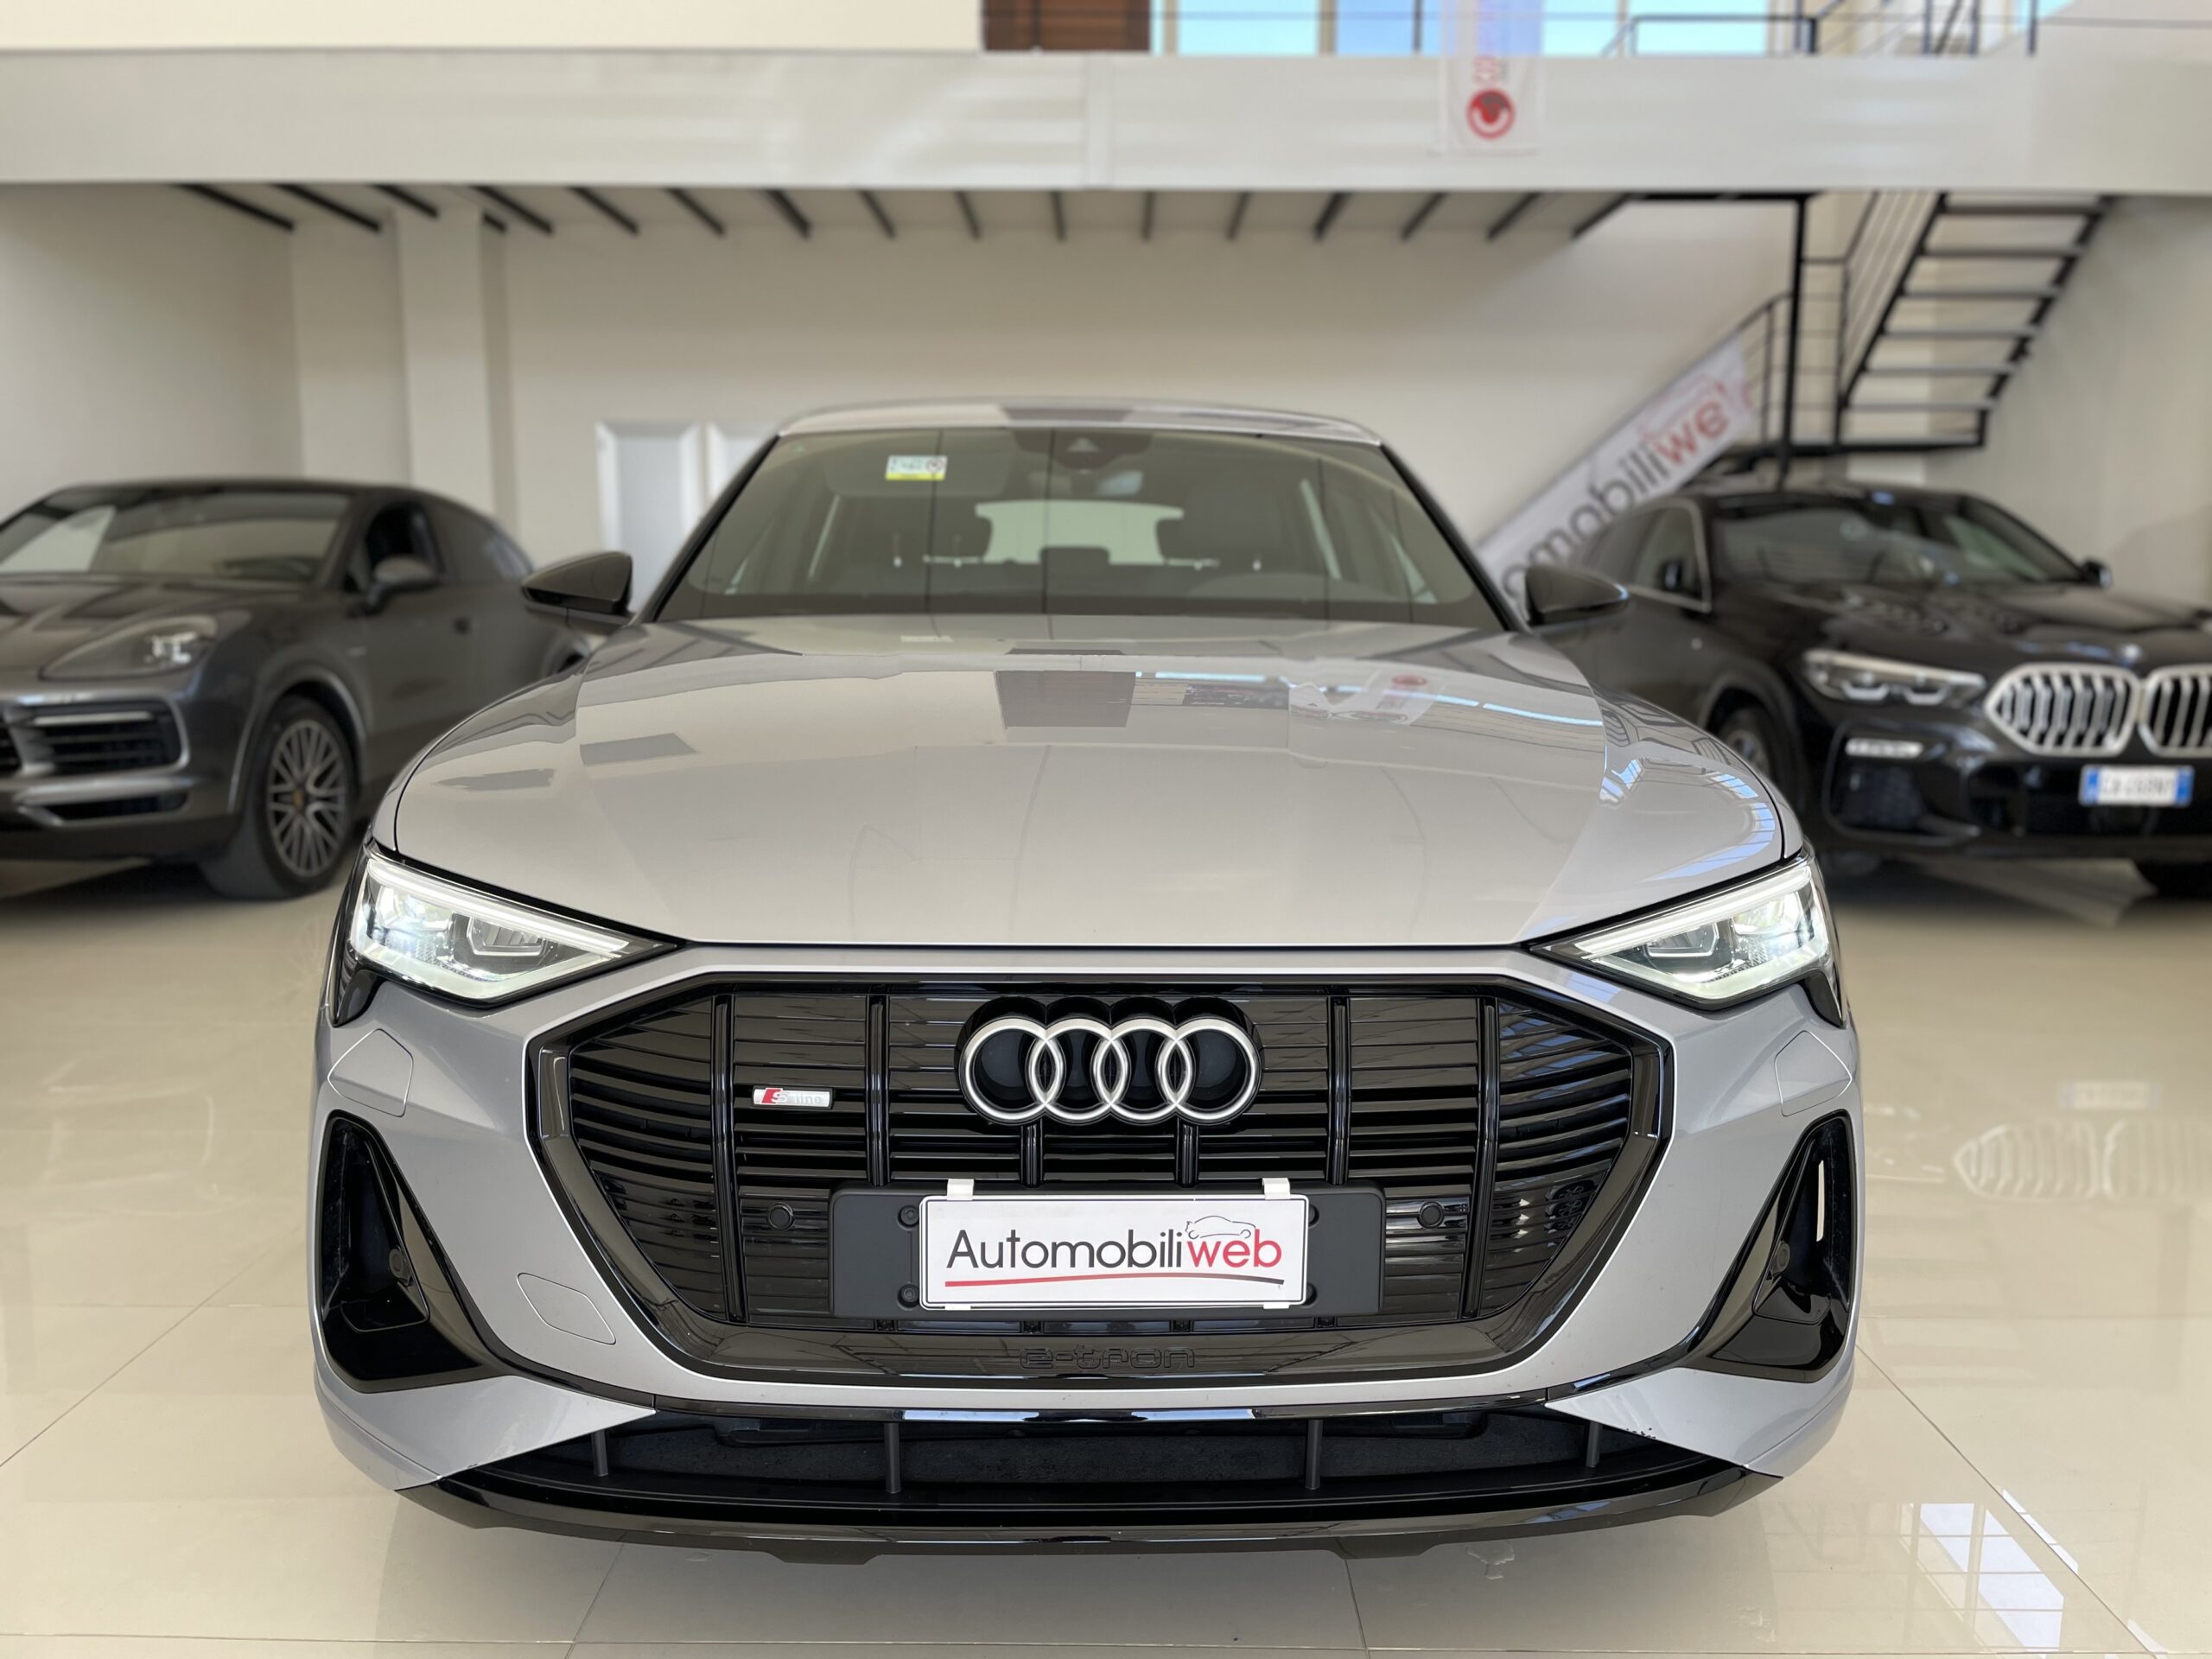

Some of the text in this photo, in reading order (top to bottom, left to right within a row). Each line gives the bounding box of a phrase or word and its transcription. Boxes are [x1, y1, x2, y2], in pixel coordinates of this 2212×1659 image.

[766, 1088, 822, 1105] S line
[945, 1228, 1282, 1269] Automobiliweb
[1020, 1344, 1195, 1370] e-tron
